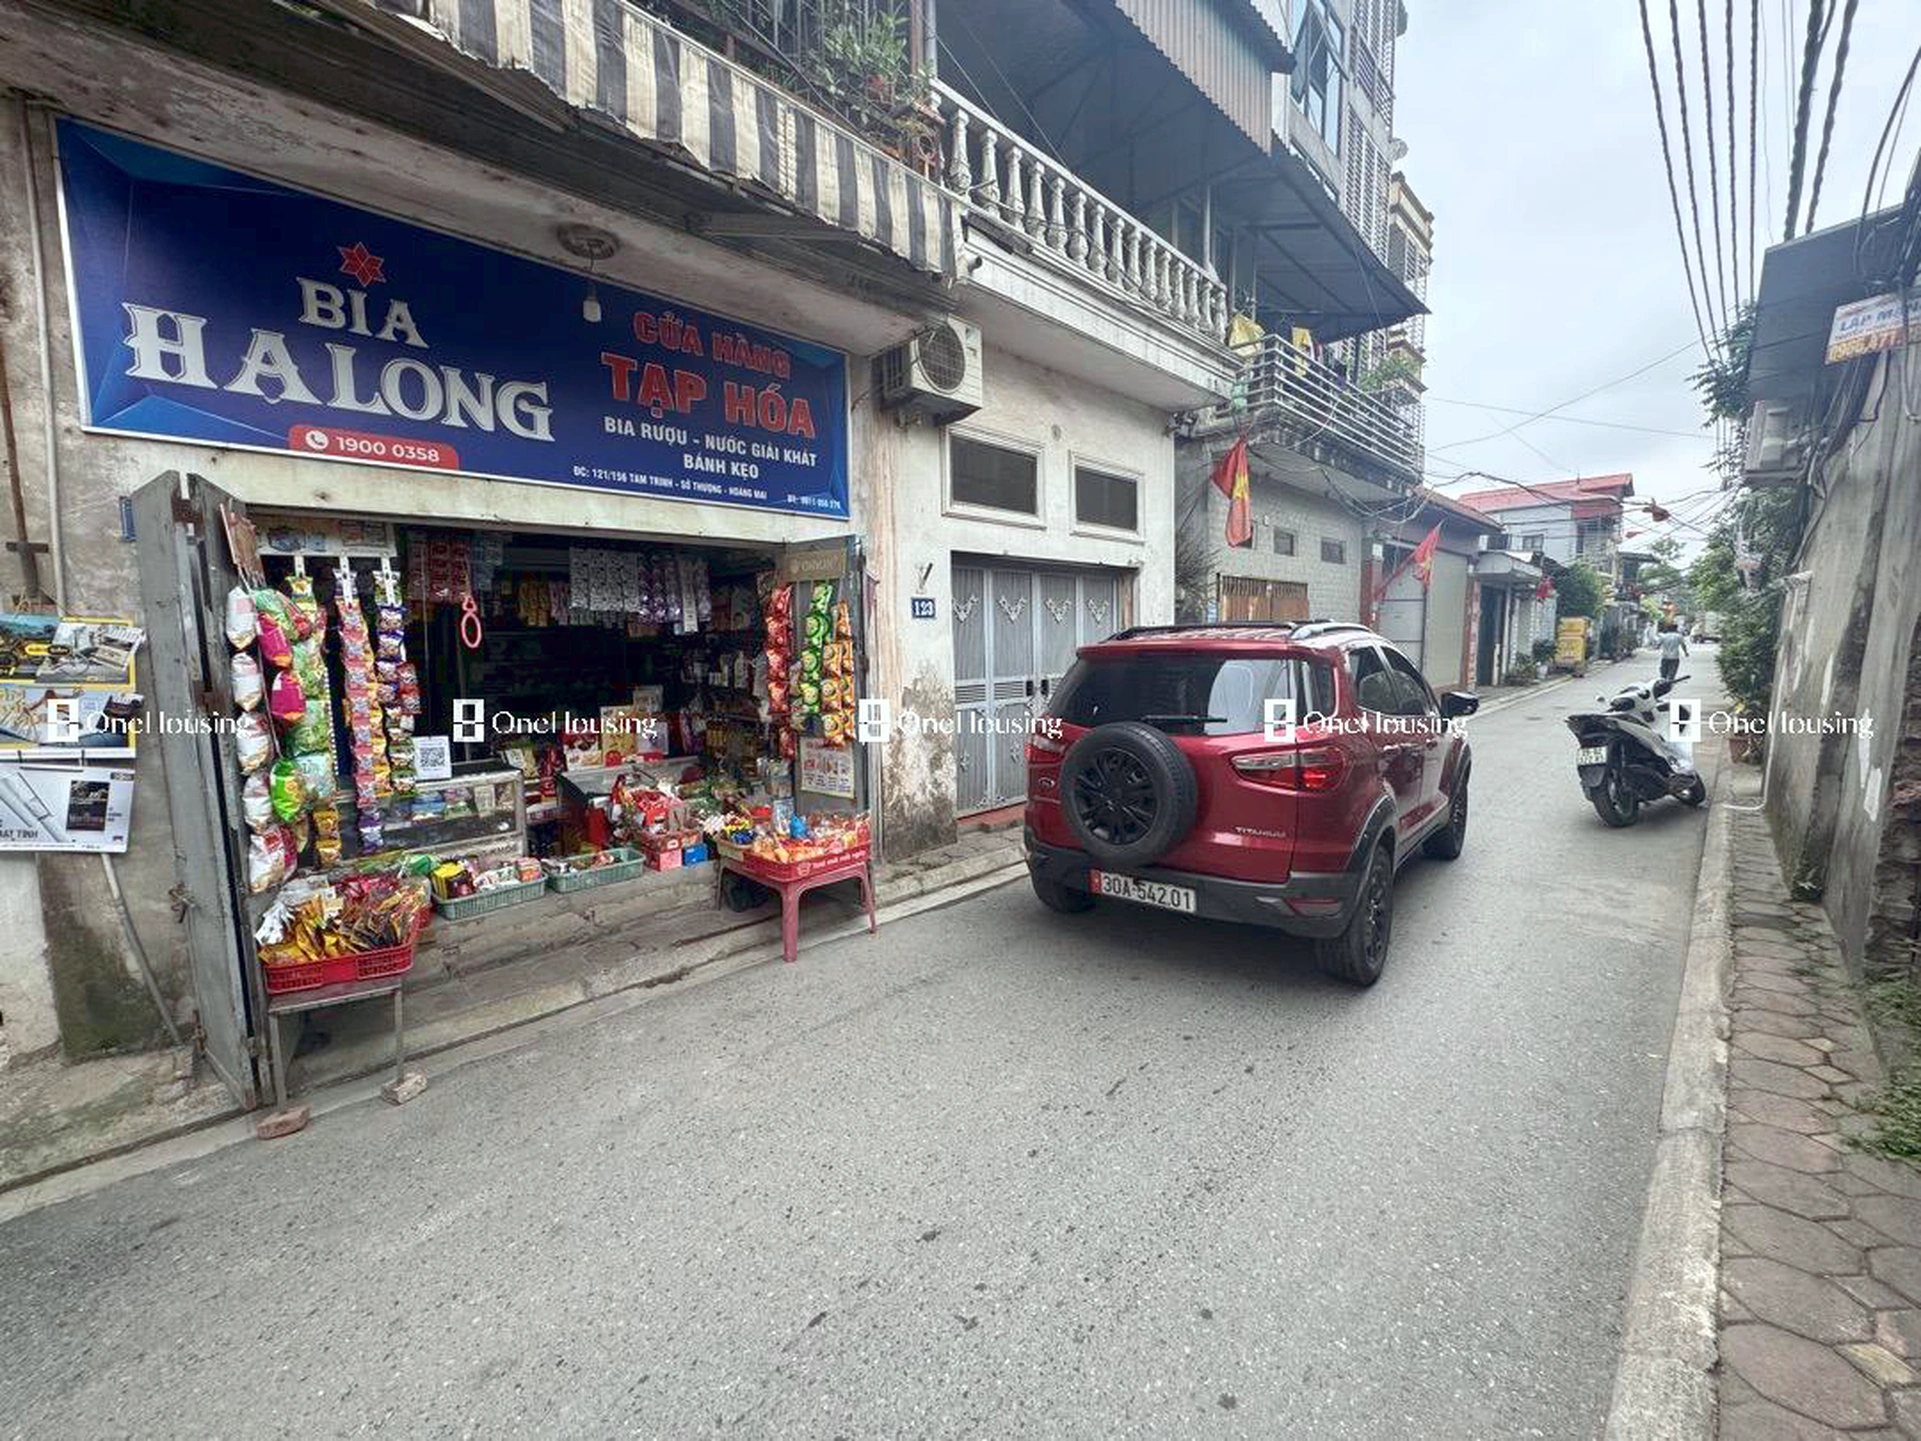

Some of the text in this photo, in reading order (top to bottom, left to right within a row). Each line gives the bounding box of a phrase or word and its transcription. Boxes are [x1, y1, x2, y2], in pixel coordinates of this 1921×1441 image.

[297, 277, 429, 349] BIA
[633, 311, 791, 381] CỬA HÀNG
[601, 351, 816, 440] TẠP HÓA
[335, 436, 441, 463] 1900 0358
[604, 416, 635, 437] BIA
[641, 423, 687, 446] RƯỢU
[704, 433, 747, 456] NƯỚC
[573, 465, 591, 478] ĐC:
[629, 473, 648, 485] TAM
[683, 452, 760, 481] BÁNH KẸO
